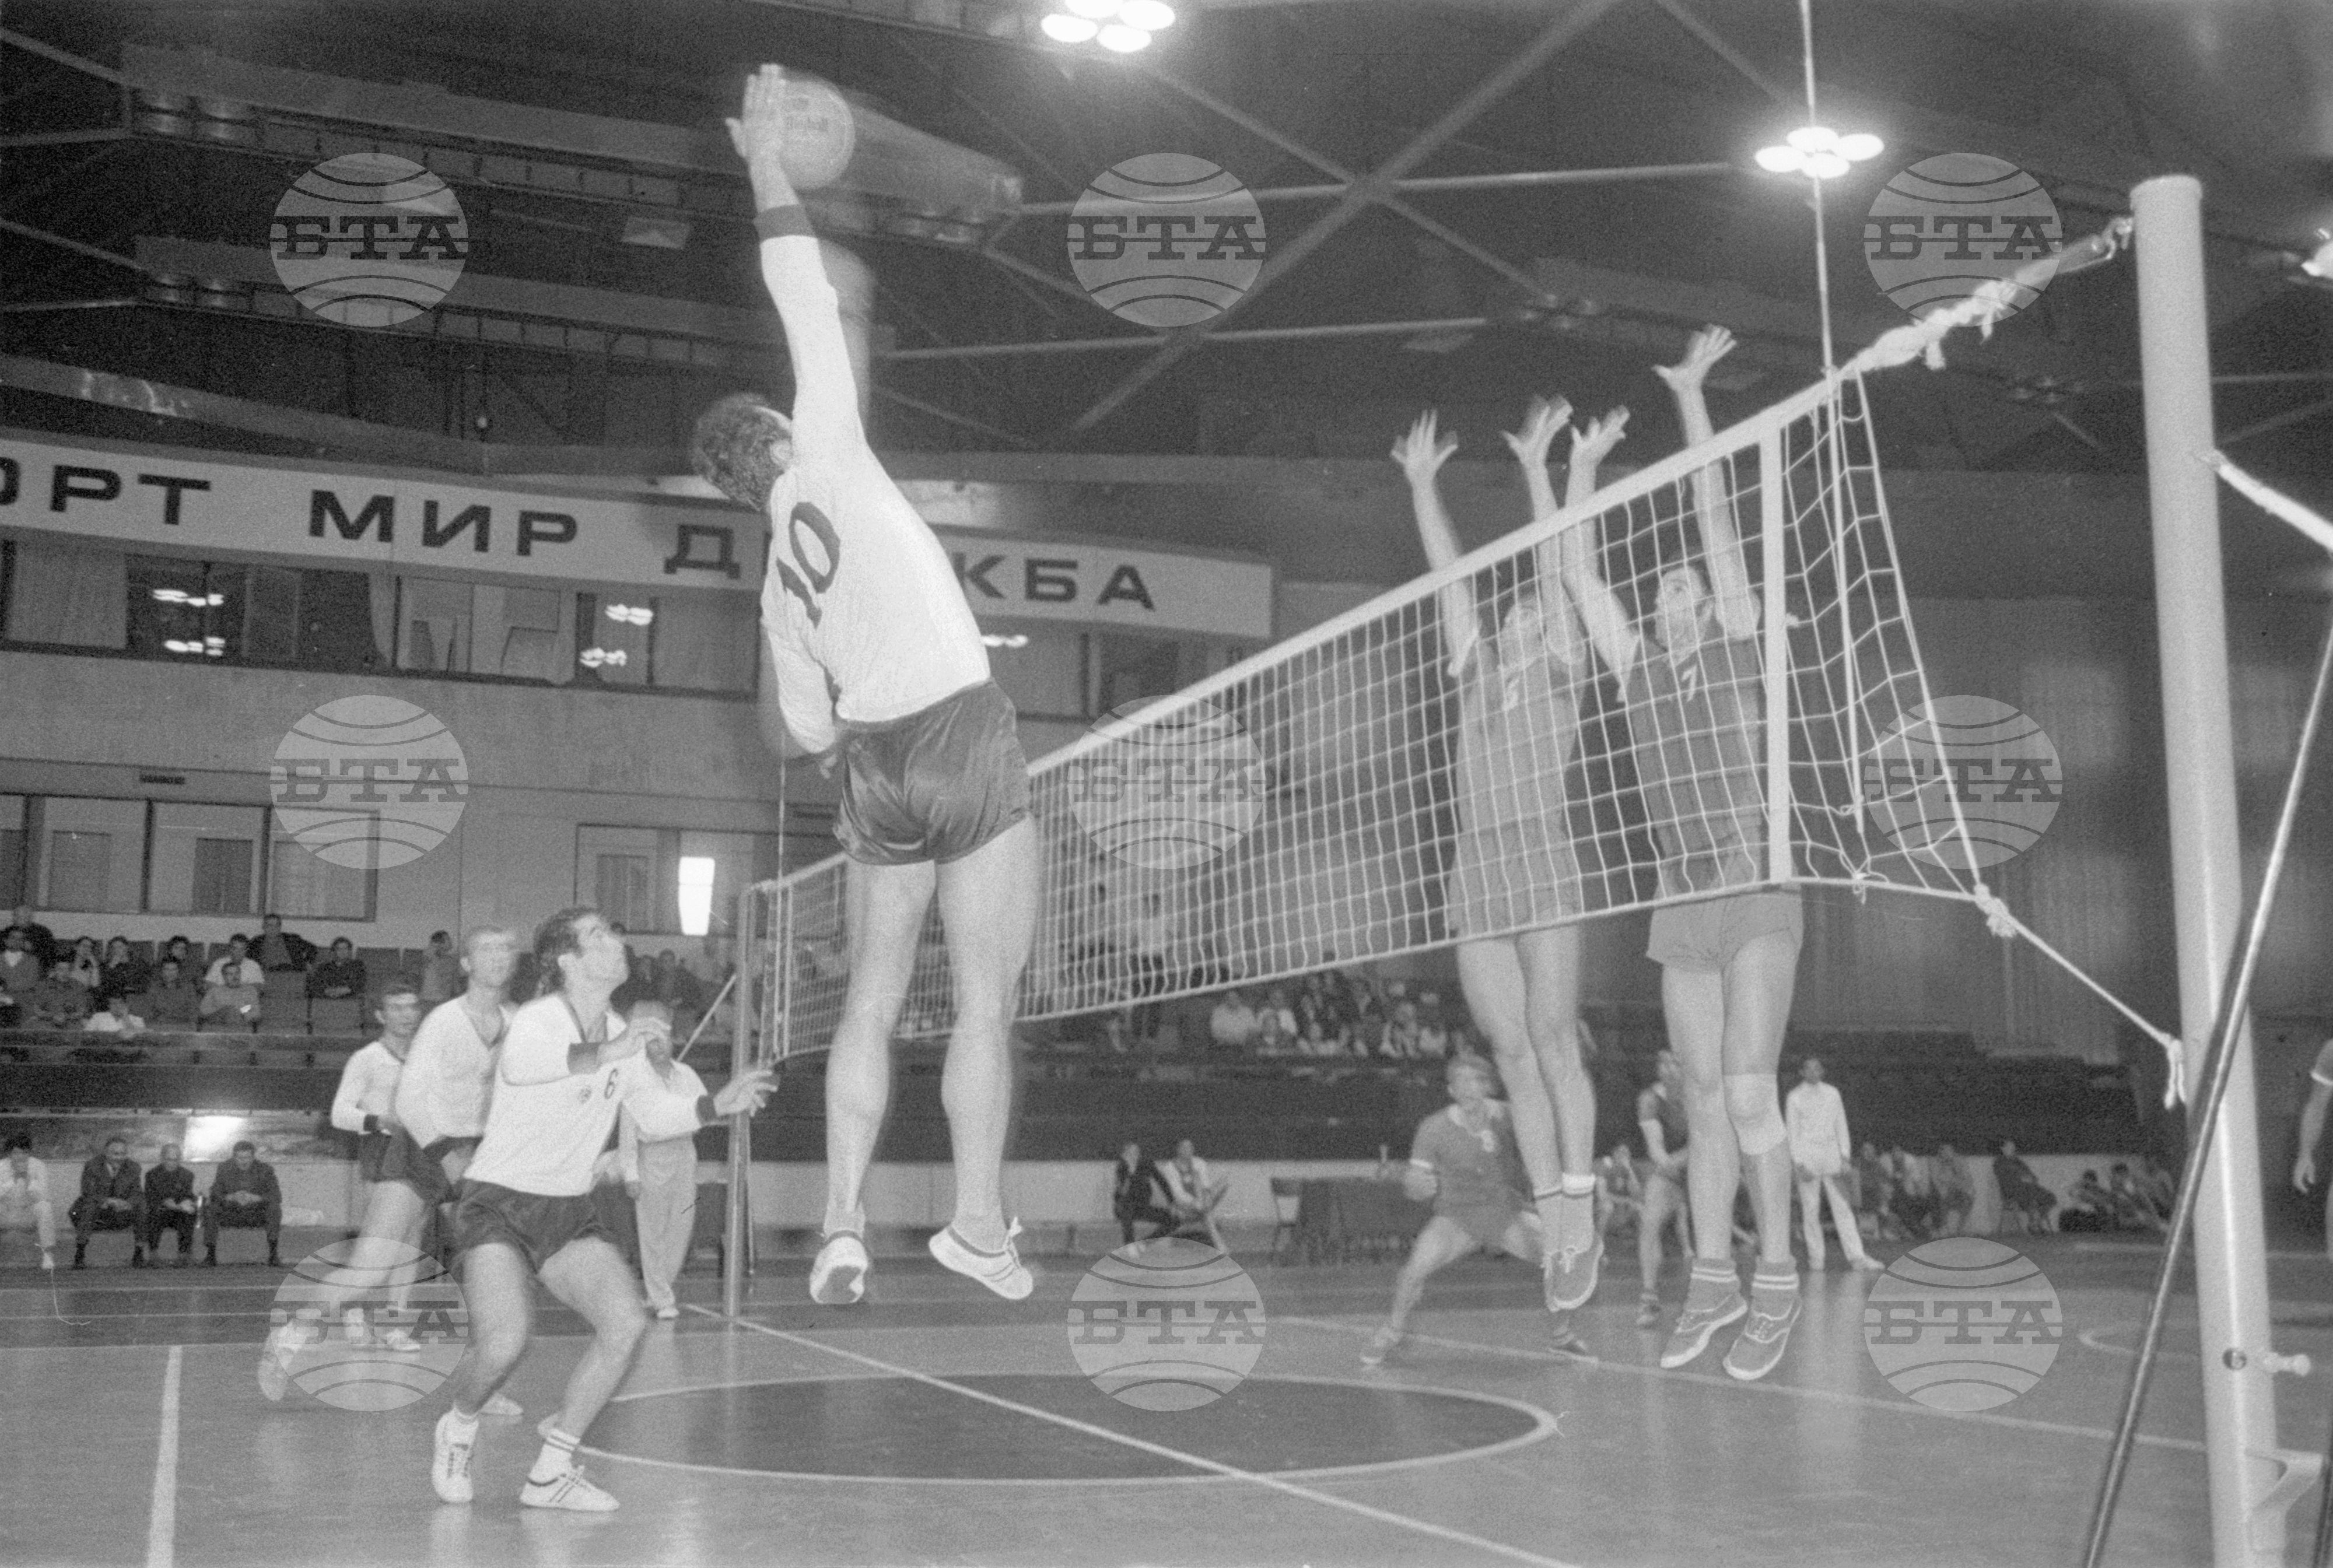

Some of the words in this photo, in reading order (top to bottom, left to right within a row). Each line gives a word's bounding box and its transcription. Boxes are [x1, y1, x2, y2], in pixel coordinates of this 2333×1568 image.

[309, 489, 578, 556] МИР
[660, 524, 1156, 612] ДБА
[776, 501, 841, 631] 10
[604, 1068, 619, 1100] 6
